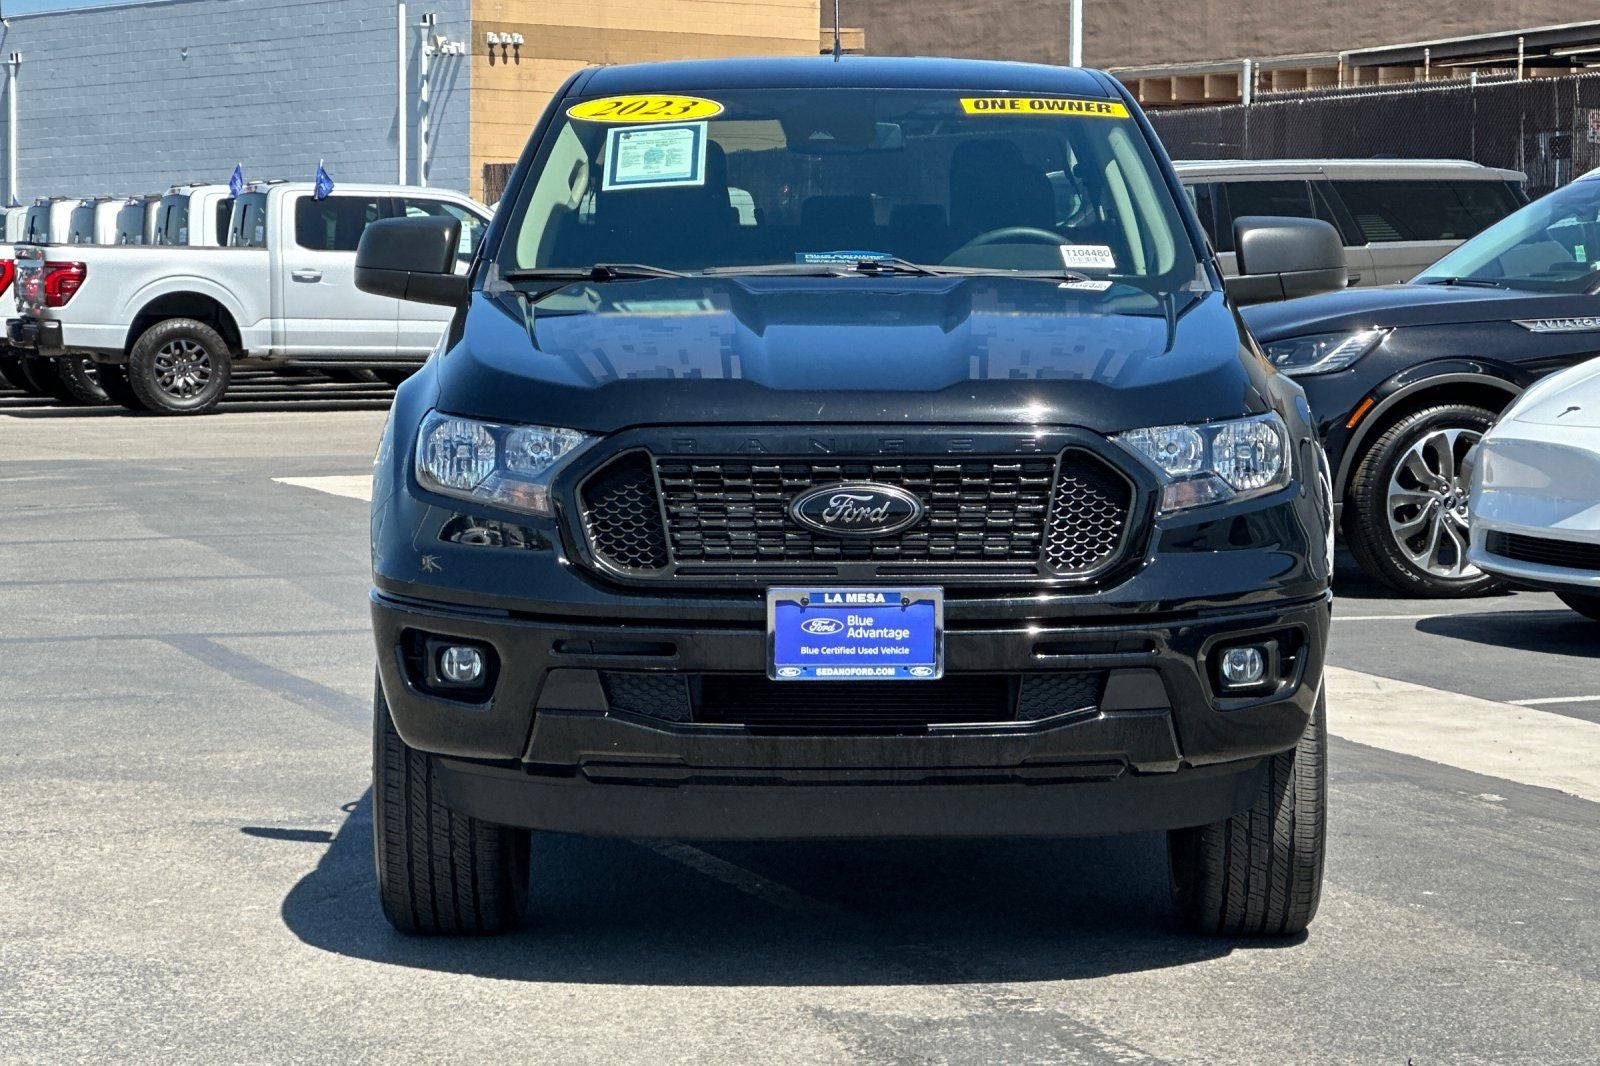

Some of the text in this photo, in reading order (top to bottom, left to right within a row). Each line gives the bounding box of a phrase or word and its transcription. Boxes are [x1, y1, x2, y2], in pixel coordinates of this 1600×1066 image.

[589, 100, 700, 117] 2023
[973, 99, 1112, 114] ONE OWNER
[1066, 249, 1110, 257] T104480
[671, 438, 1042, 453] RANGER
[822, 494, 891, 523] Ford
[824, 593, 886, 603] LA MESA
[808, 618, 837, 633] Ford
[847, 615, 873, 626] Blue
[847, 627, 910, 640] Advantage
[800, 646, 910, 655] Blue Certified Used Vehicle
[816, 667, 895, 676] SEDANOFORD.COM
